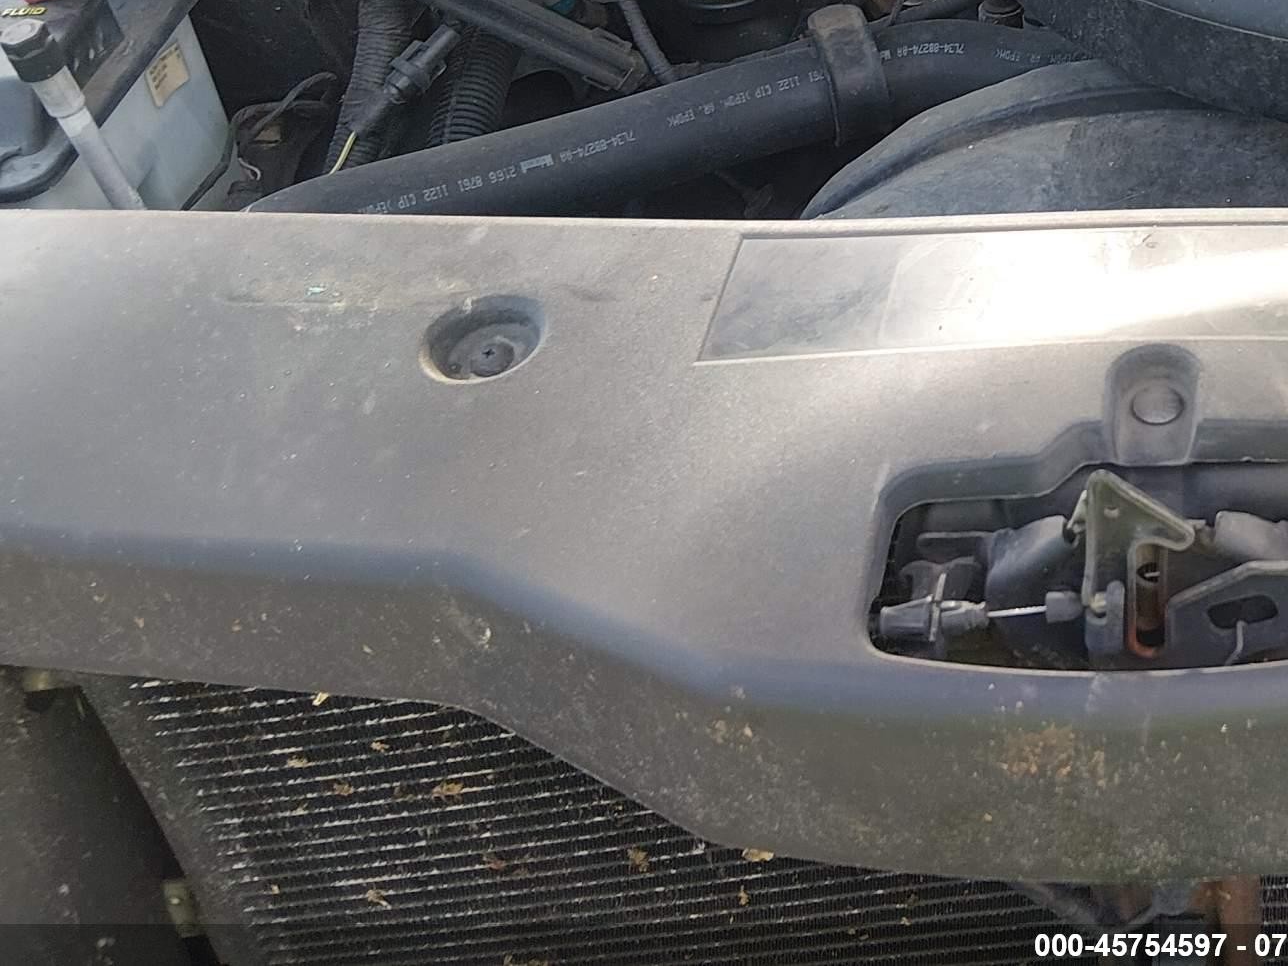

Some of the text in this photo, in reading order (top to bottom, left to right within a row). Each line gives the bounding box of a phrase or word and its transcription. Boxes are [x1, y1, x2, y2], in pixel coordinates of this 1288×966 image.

[1, 6, 48, 17] FLUID
[778, 75, 801, 92] 1122
[488, 164, 518, 185] 2166
[422, 184, 450, 203] 1122
